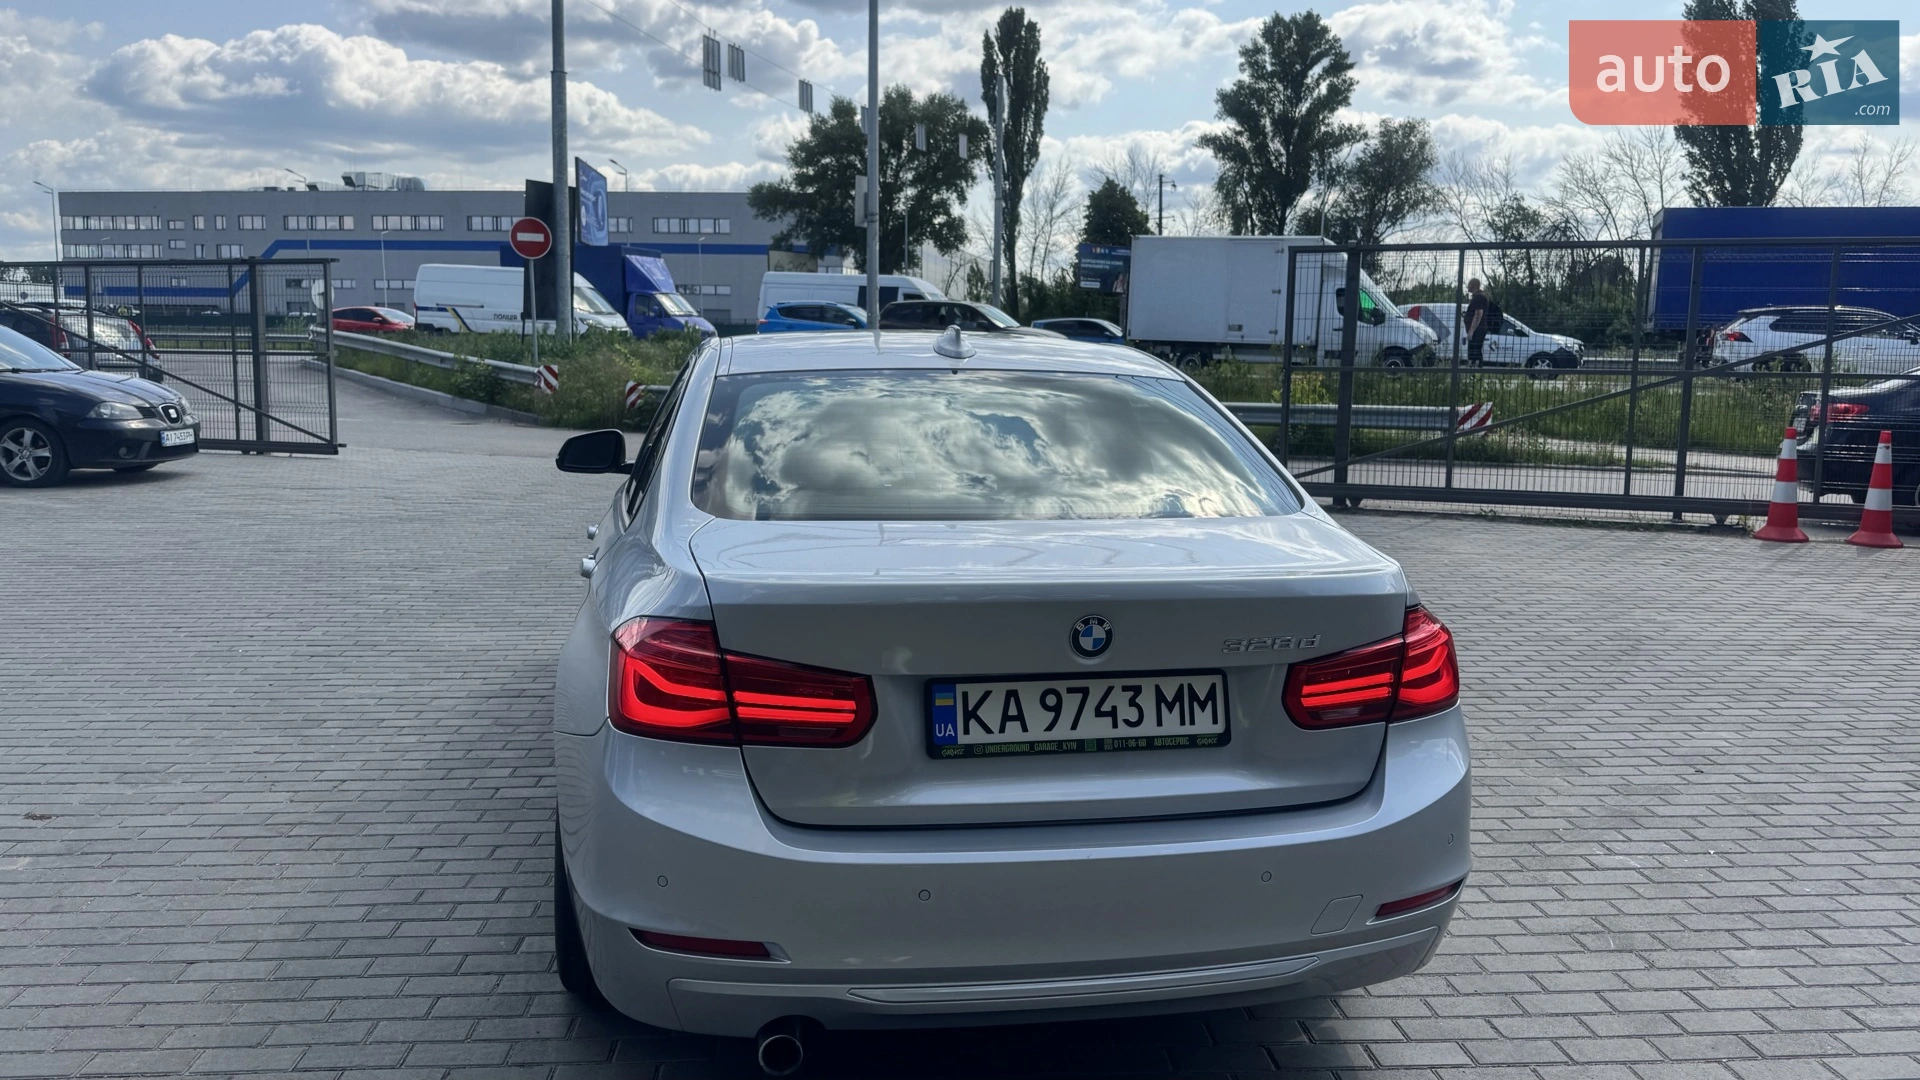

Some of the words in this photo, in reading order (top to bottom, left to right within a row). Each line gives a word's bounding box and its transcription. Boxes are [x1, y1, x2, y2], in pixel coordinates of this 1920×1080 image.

[961, 688, 1030, 736] KA
[1039, 685, 1145, 732] 9743
[1154, 682, 1219, 727] MM
[935, 723, 955, 737] UA
